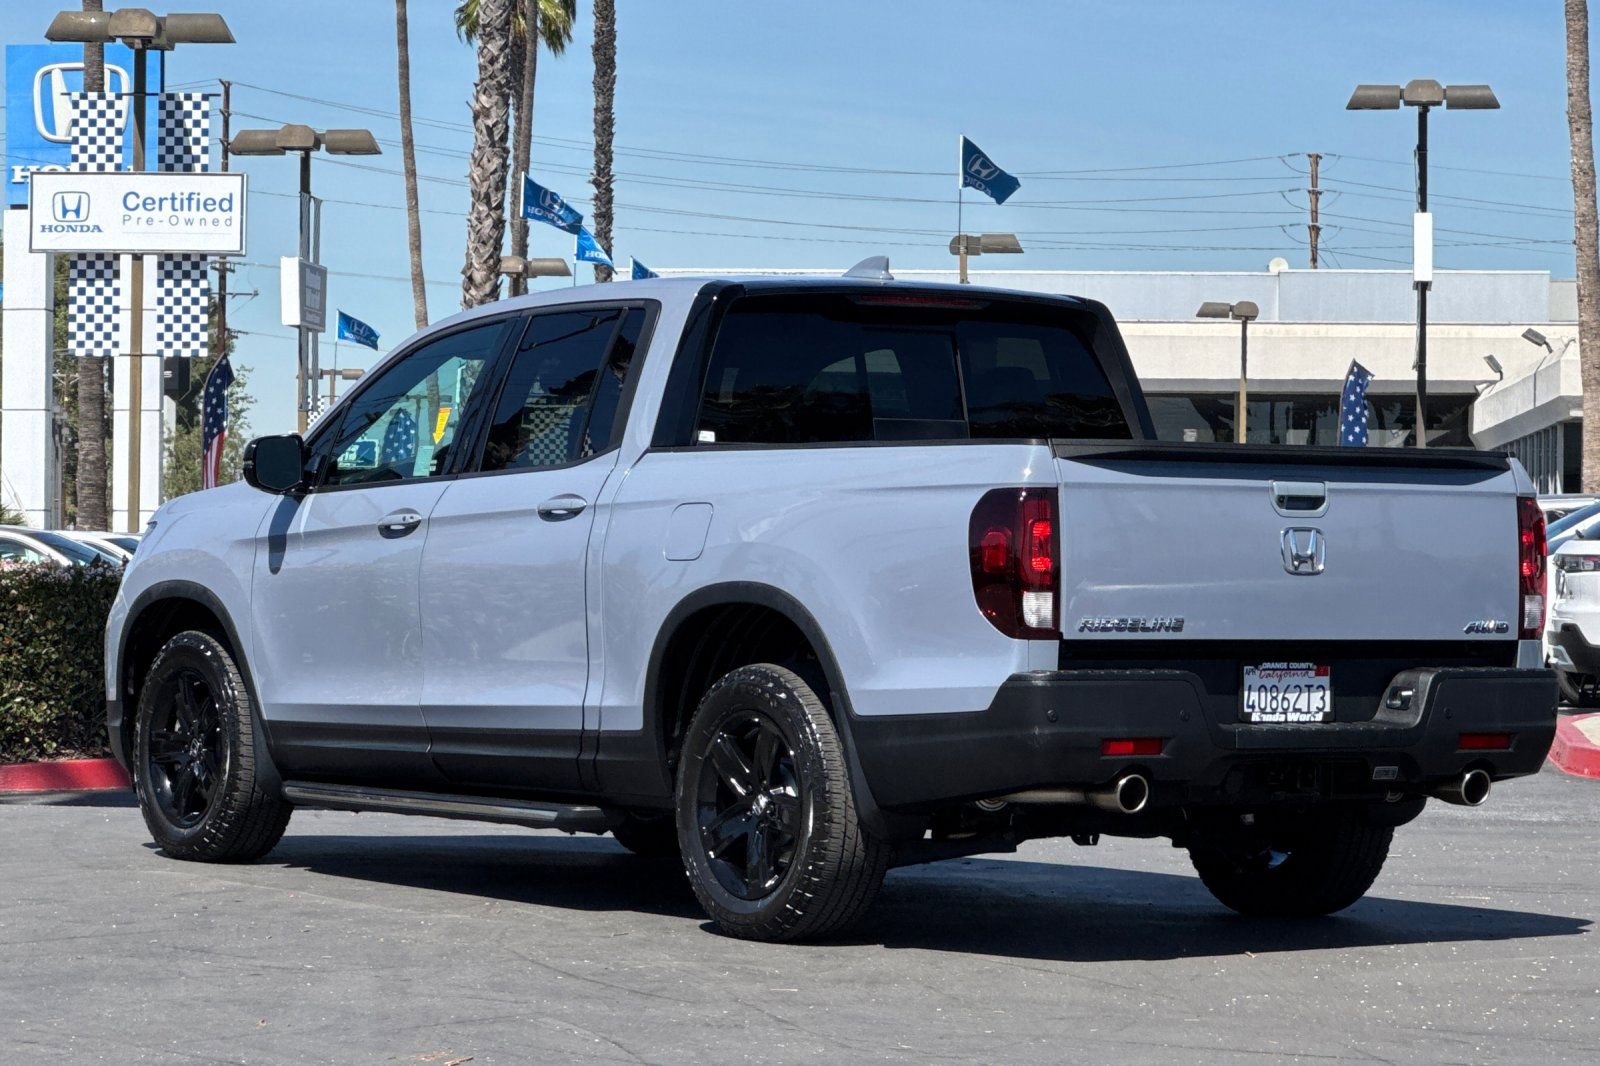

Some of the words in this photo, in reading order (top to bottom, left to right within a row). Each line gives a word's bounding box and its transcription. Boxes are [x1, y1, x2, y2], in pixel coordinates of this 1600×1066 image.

[122, 191, 233, 213] Certified
[122, 214, 233, 227] Pre-Owned
[40, 224, 103, 233] HONDA
[1078, 616, 1185, 633] RIDGELINE
[1463, 620, 1509, 634] AWD
[1289, 662, 1314, 670] COUNTY
[1246, 684, 1326, 713] 40862T3
